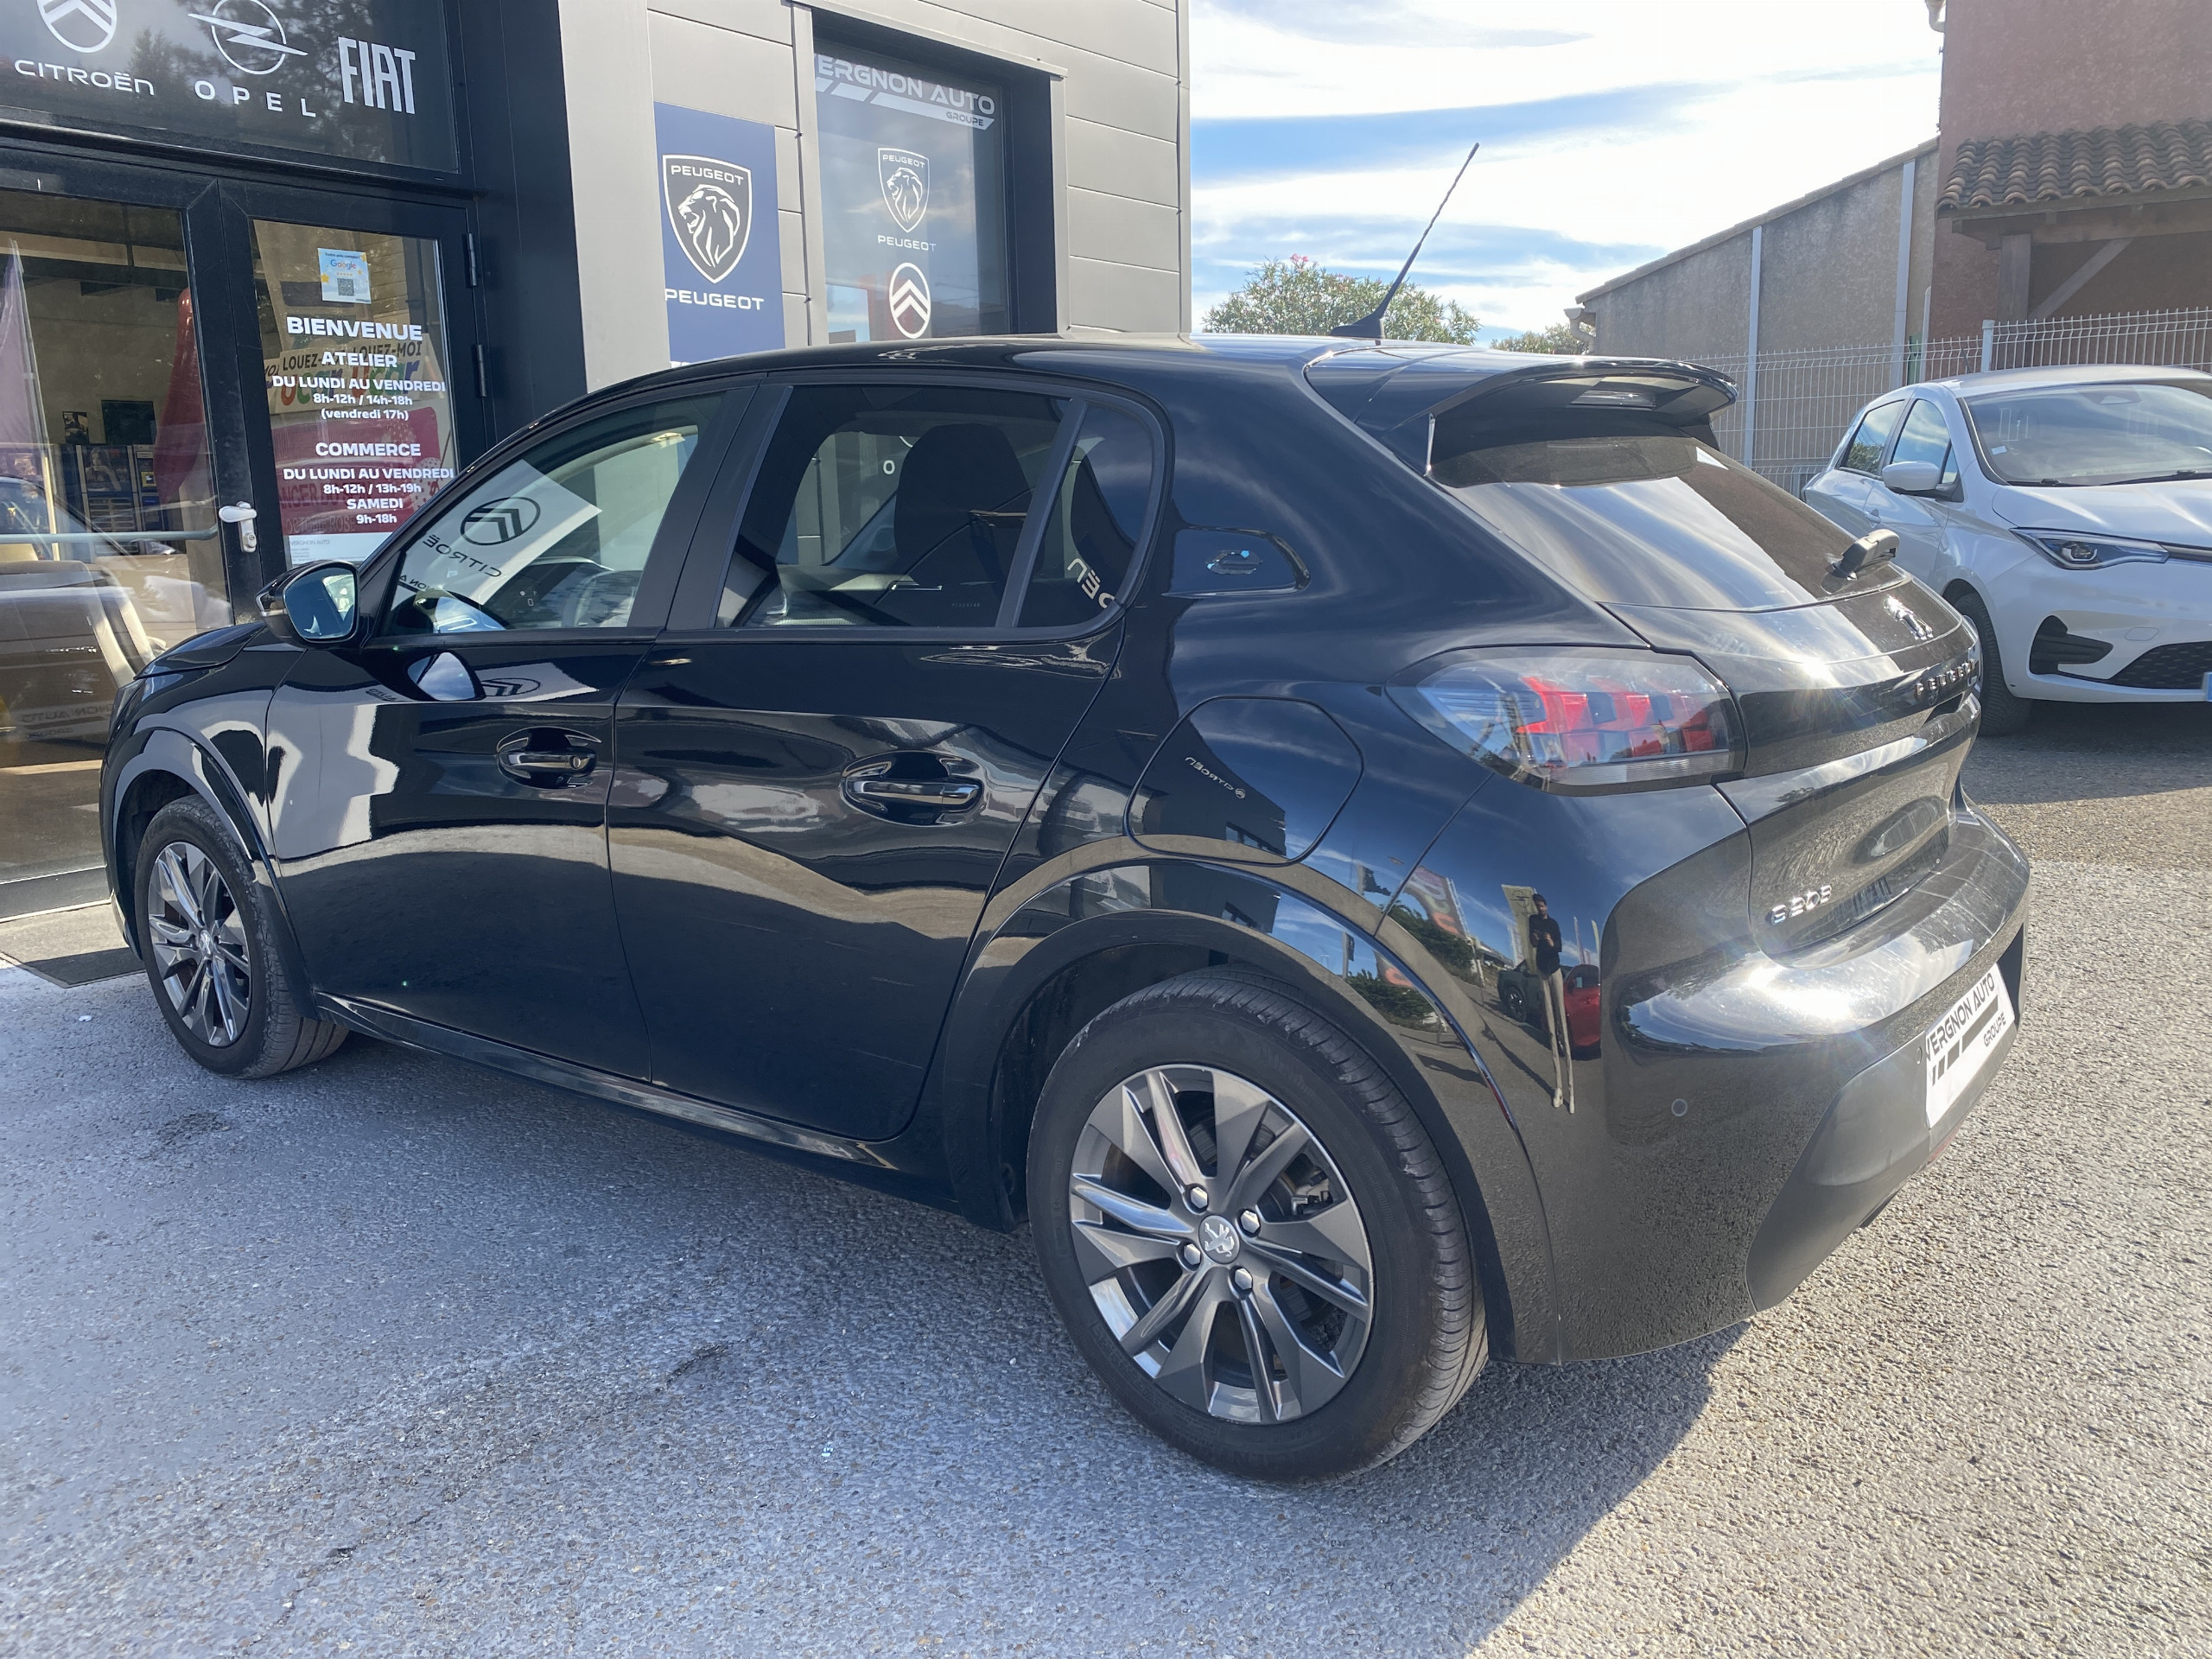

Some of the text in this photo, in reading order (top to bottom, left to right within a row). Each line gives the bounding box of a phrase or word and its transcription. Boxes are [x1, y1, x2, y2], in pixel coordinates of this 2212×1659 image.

[15, 60, 154, 96] CITROËN
[338, 36, 416, 115] FIAT
[814, 54, 995, 115] ERGNON AUTO
[194, 80, 316, 118] OPEL
[946, 111, 984, 127] GROUPE
[882, 154, 925, 169] PEUGEOT
[671, 164, 744, 186] PEUGEOT
[877, 235, 937, 251] PEUGEOT
[330, 259, 357, 270] Google
[664, 289, 764, 311] PEUGEOT
[286, 316, 423, 340] BIENVENUE
[321, 352, 397, 367] ATELIER
[272, 375, 446, 392] DU LUNDI AU VENDREDI
[313, 393, 356, 404] 8h-12h
[366, 395, 413, 405] 14h-18h
[321, 408, 409, 421] (vendredi 17h)
[315, 442, 421, 456] COMMERCE
[283, 467, 454, 480] DU LUNDI AU VENDREDI
[323, 484, 365, 495] 8h-12h
[376, 483, 422, 493] 13h-19h
[346, 498, 404, 510] SAMEDI
[356, 514, 397, 524] 9h-18h
[1926, 972, 1995, 1061] VERGNON AUTO
[1983, 1012, 2006, 1047] GROUPE
